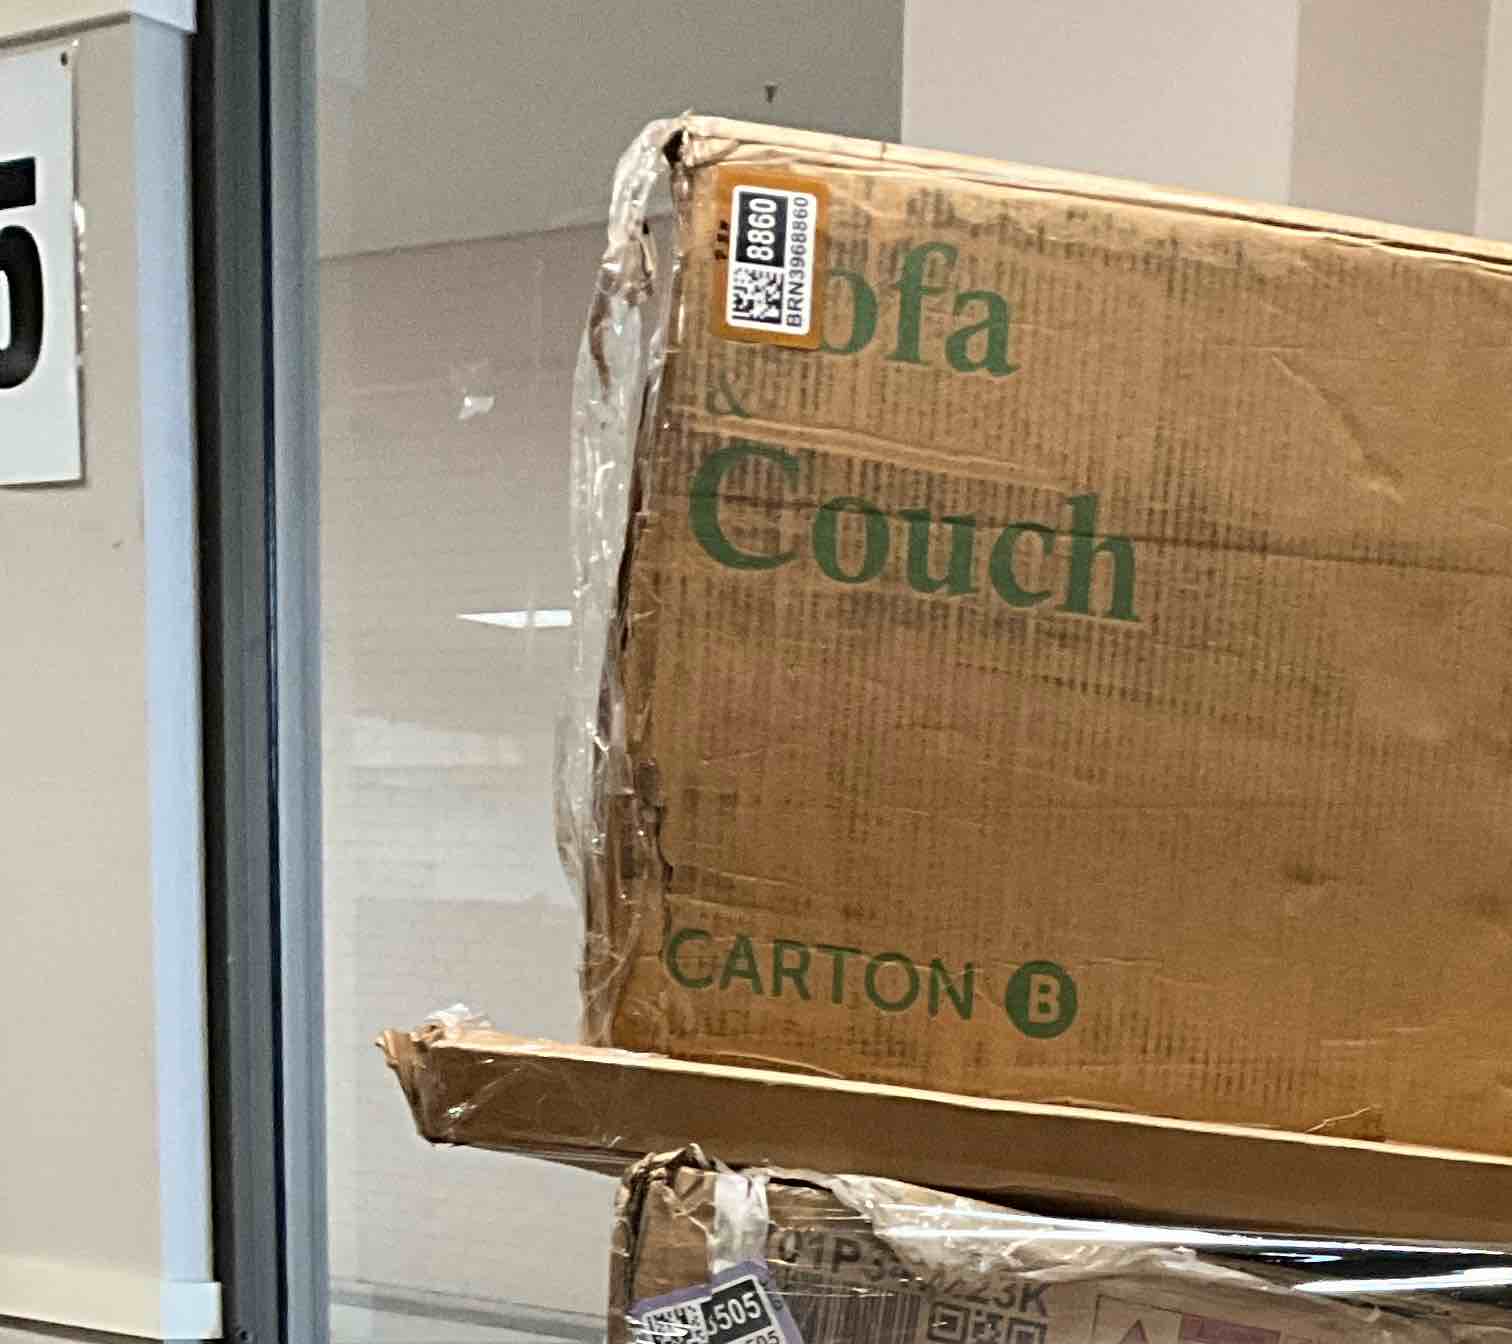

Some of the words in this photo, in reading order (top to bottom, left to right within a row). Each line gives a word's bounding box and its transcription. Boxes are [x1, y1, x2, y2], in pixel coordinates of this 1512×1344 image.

[746, 197, 777, 261] 8860
[786, 196, 809, 328] BRN3968860
[818, 241, 1021, 378] ofa
[704, 361, 752, 418] &
[687, 443, 1143, 624] Couch
[666, 928, 975, 1022] CARTON
